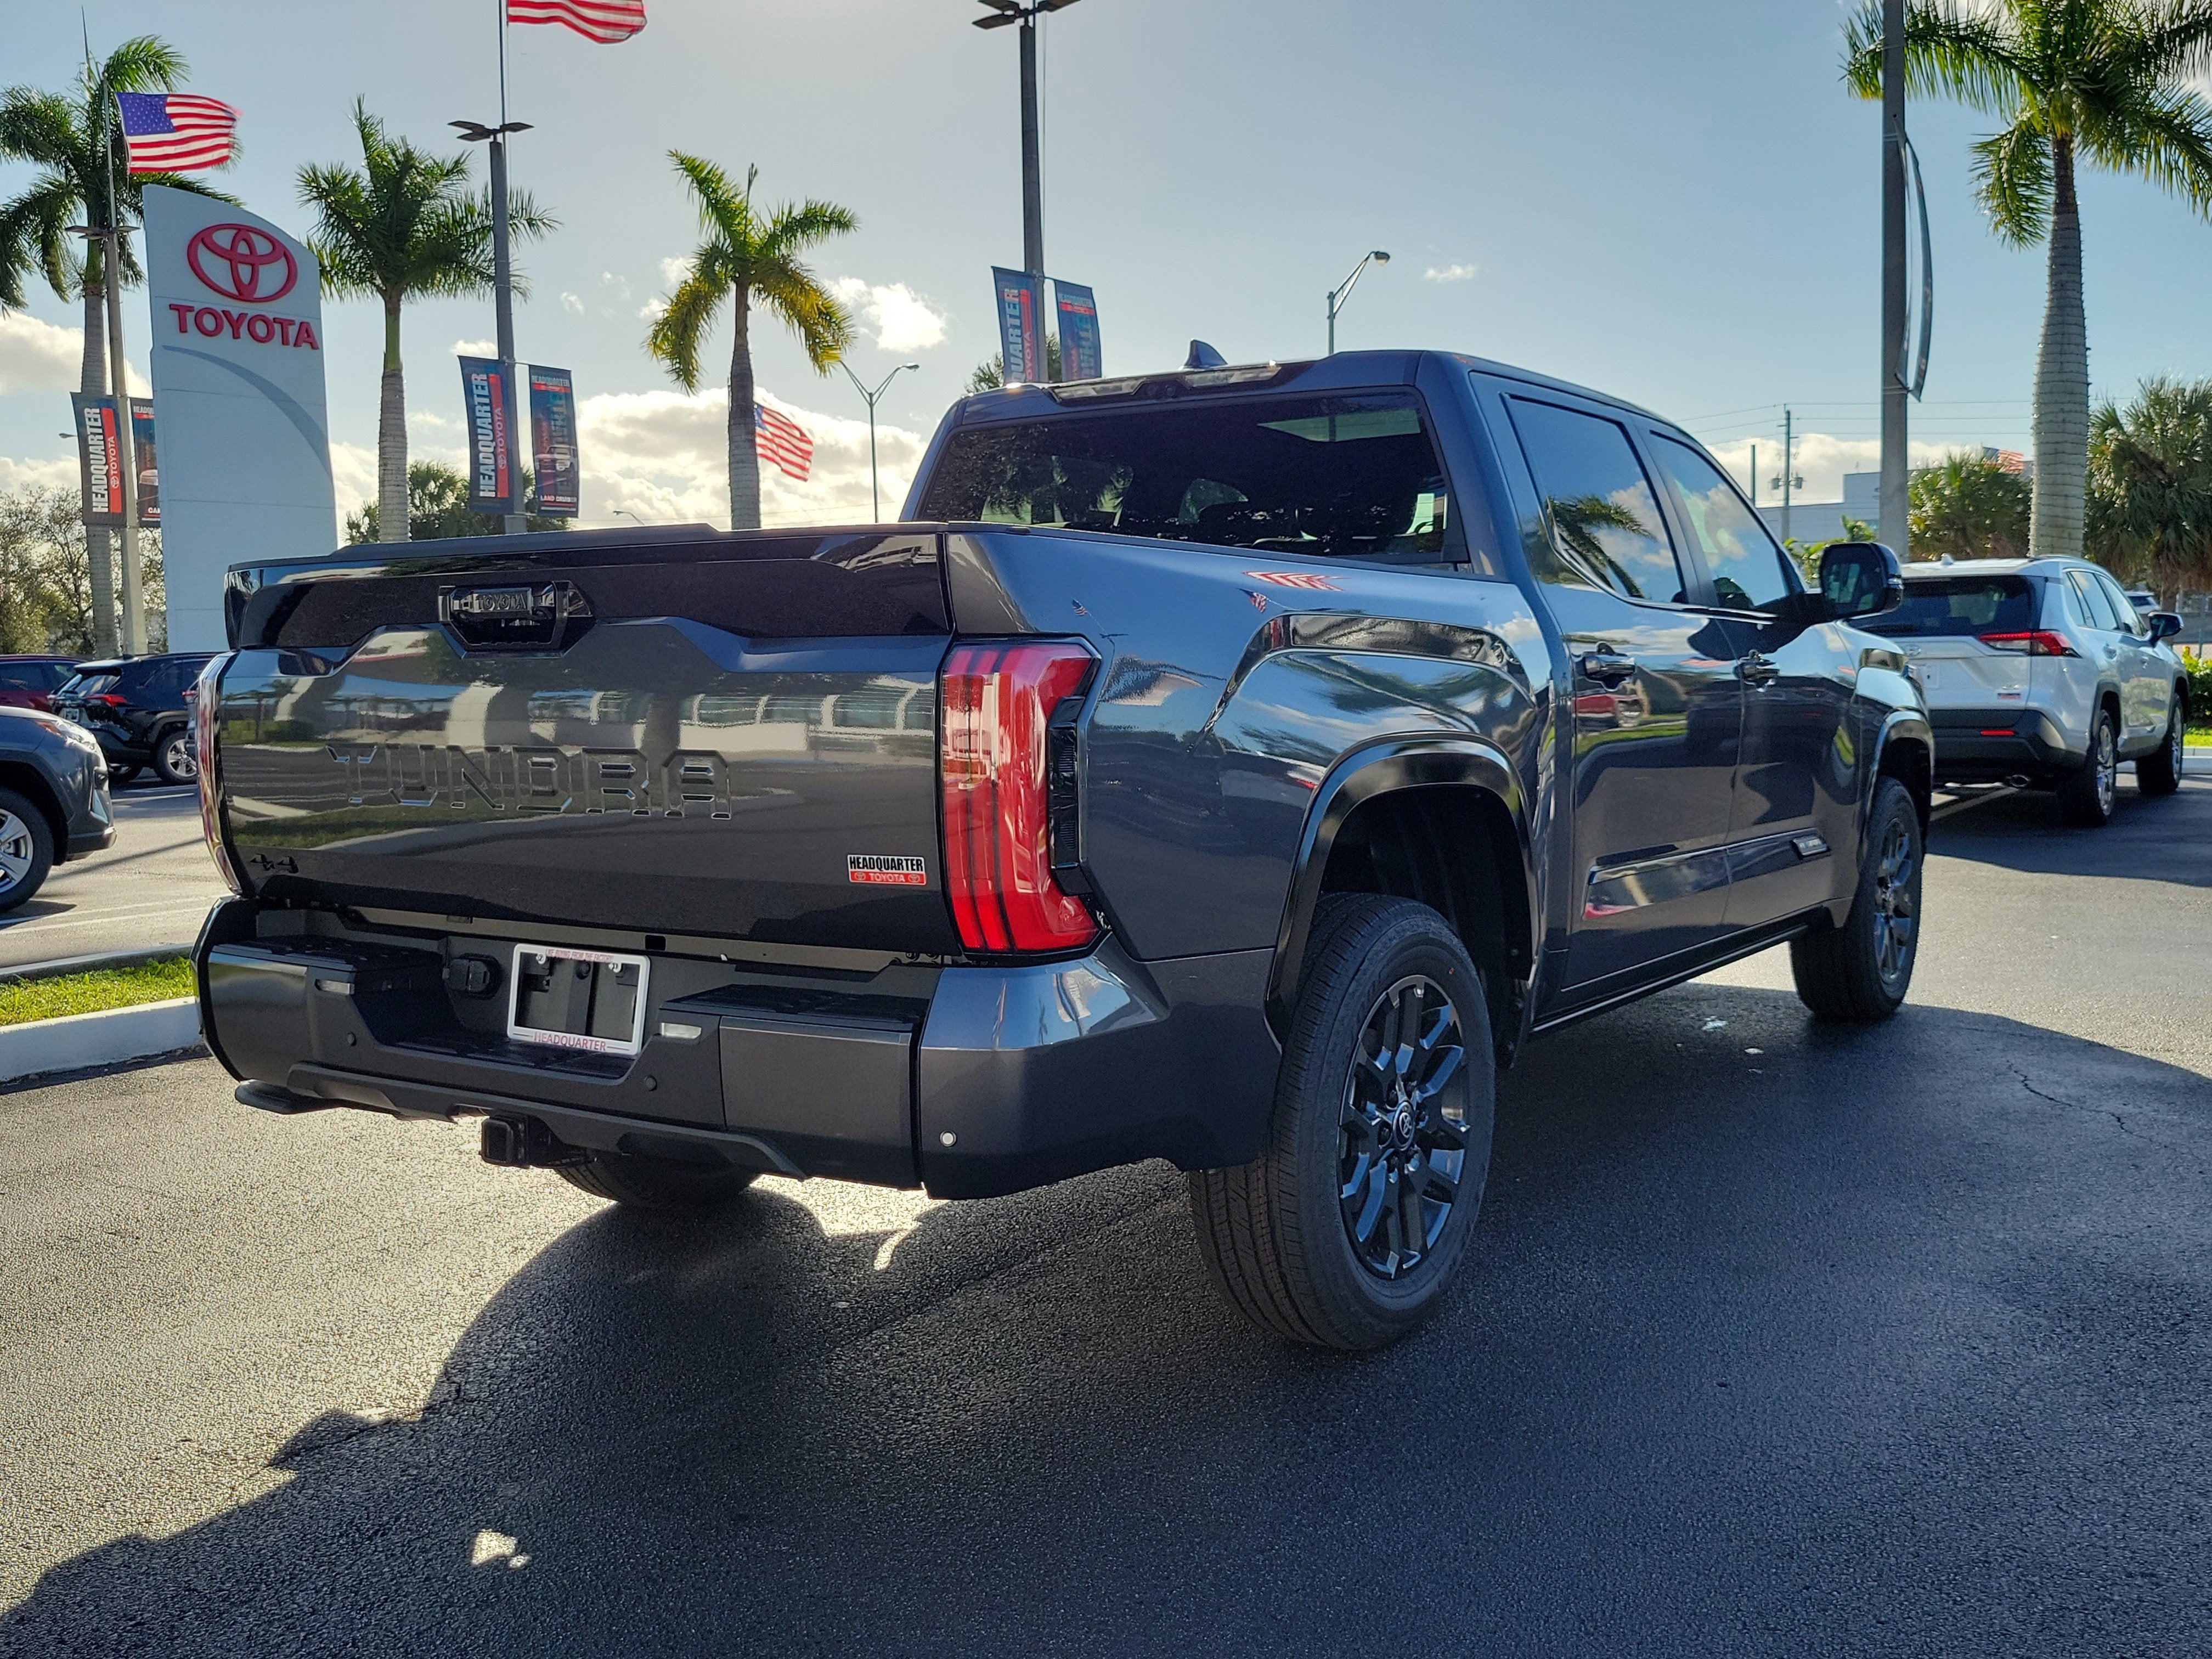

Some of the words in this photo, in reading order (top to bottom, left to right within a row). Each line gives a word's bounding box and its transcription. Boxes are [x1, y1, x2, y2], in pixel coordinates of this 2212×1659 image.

[169, 304, 320, 350] TOYOTA
[1024, 331, 1035, 382] OYOTA
[471, 374, 495, 497] HEADQUARTER
[494, 407, 505, 454] TOYOTA
[84, 408, 109, 512] HEADQUARTER
[108, 436, 118, 475] TOYOTA
[476, 594, 527, 612] TOYOTA
[325, 744, 732, 821] TUNDRA
[850, 856, 923, 872] HEADQUARTER
[868, 873, 905, 882] TOYOTA
[533, 1031, 607, 1051] HEADQUARTER
